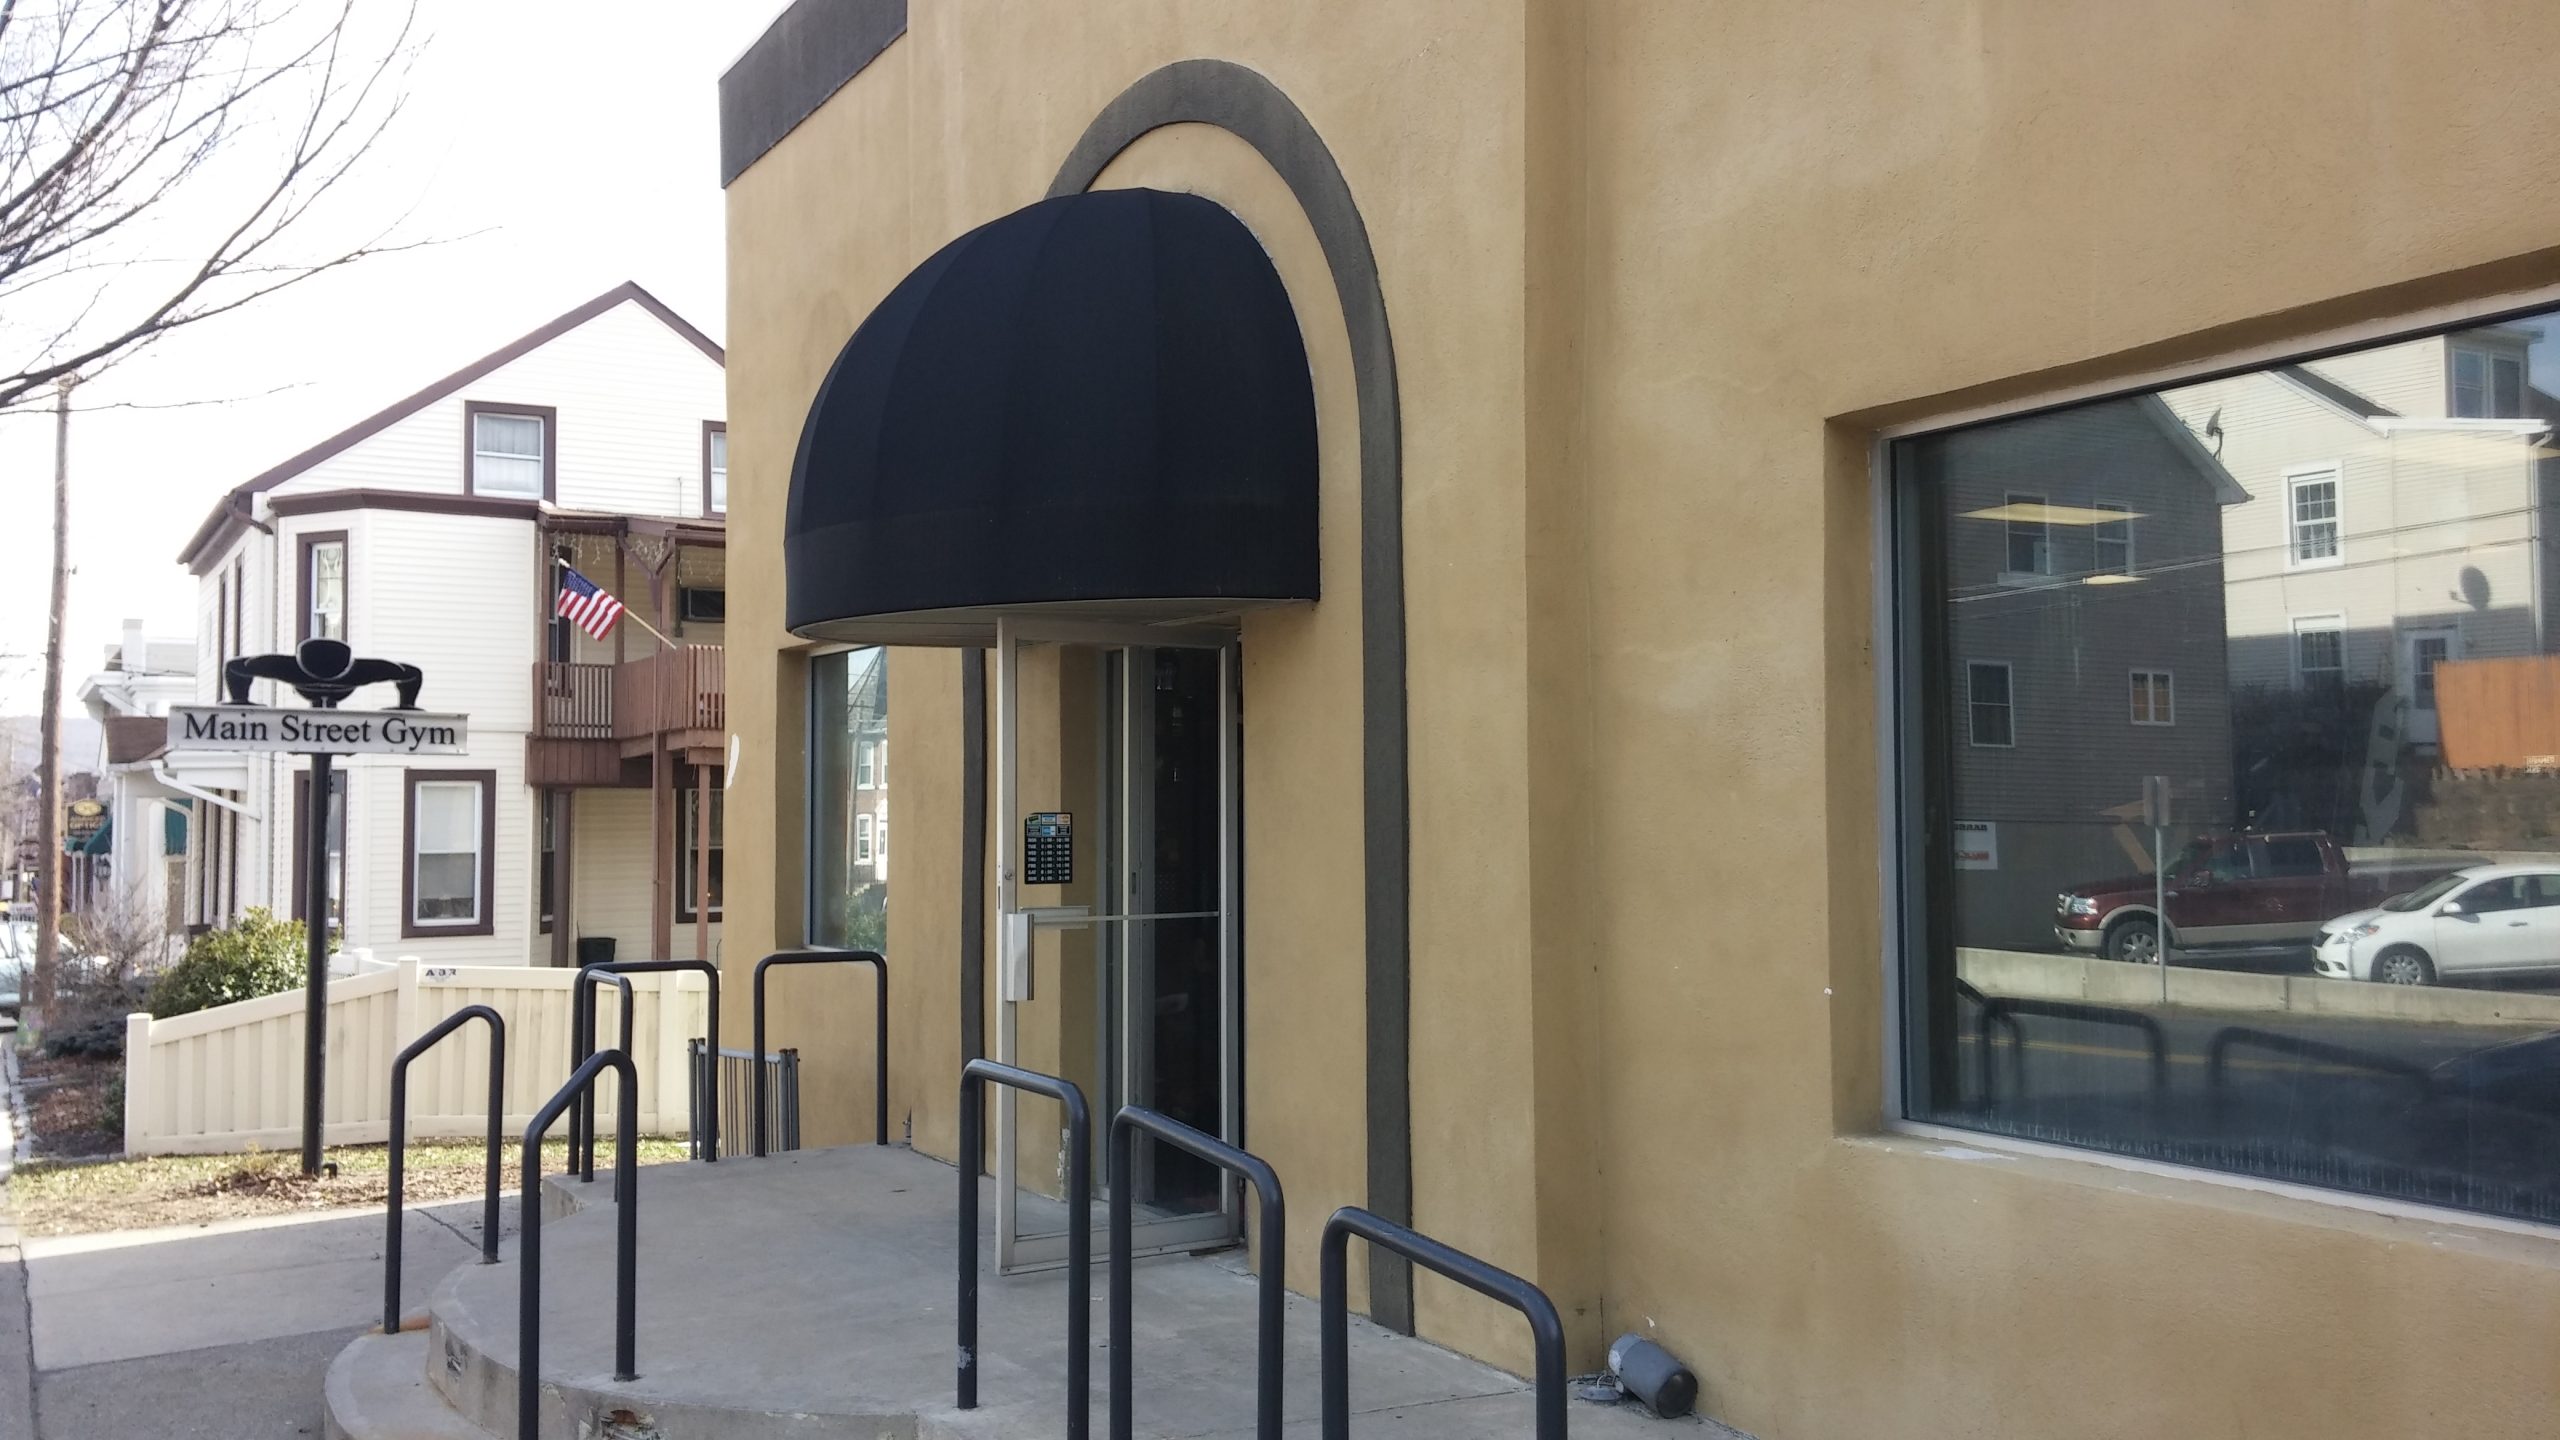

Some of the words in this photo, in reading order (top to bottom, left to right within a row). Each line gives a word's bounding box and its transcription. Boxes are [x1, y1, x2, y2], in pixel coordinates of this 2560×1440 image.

[184, 712, 269, 741] Main
[281, 714, 371, 743] Street
[382, 717, 456, 750] Gym
